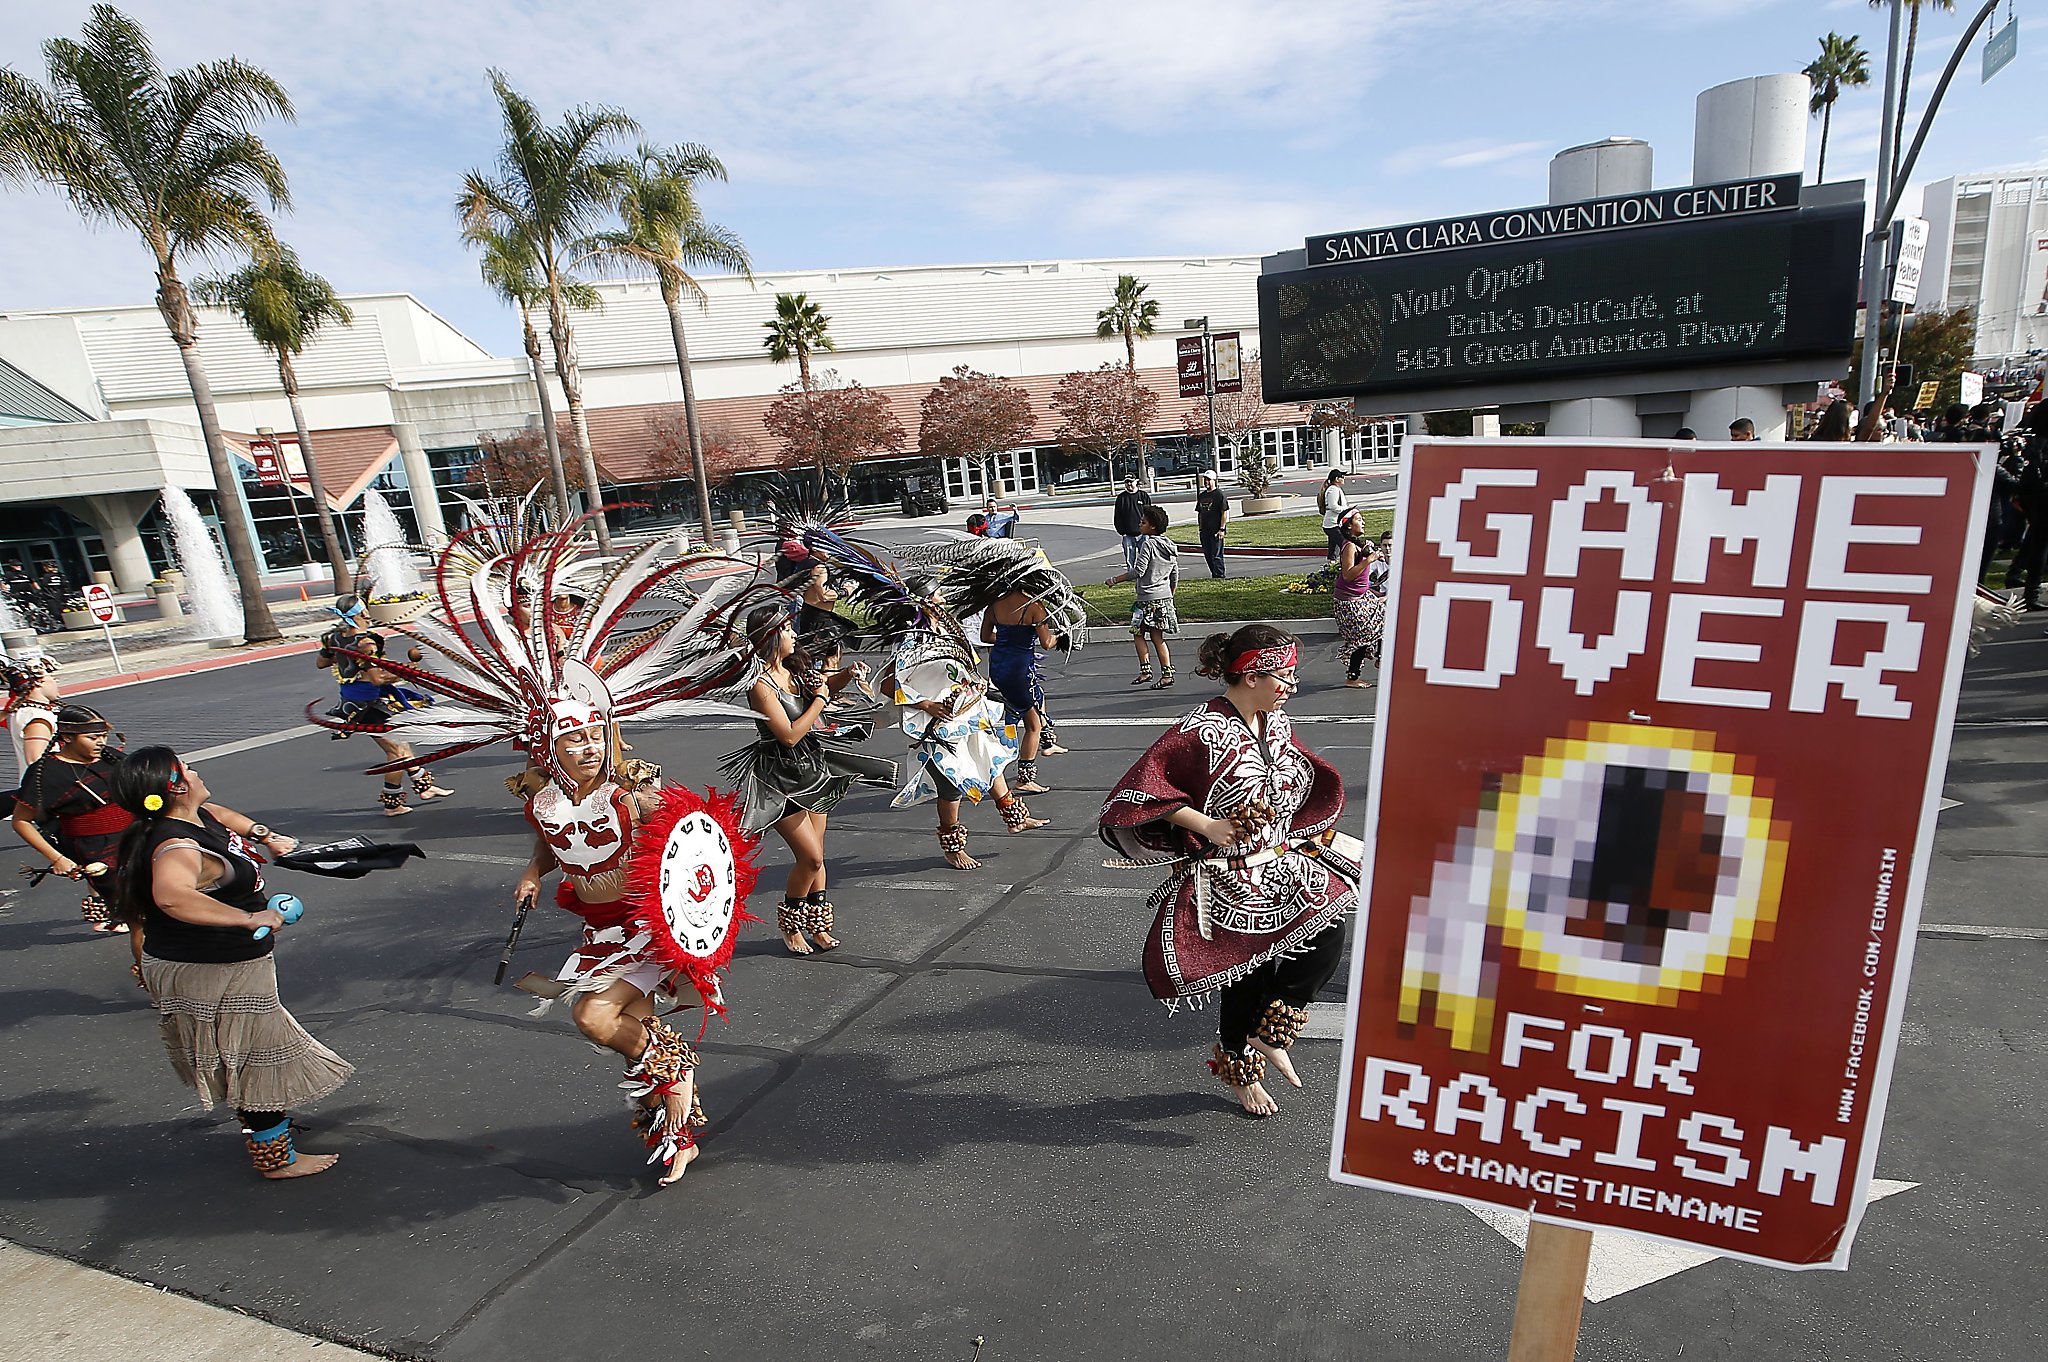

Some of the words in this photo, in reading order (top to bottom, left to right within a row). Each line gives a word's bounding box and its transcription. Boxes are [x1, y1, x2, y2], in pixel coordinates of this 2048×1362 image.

[1324, 231, 1400, 262] SANTA
[1405, 220, 1484, 251] CLARA
[1489, 195, 1664, 241] CONVENTION
[1673, 181, 1778, 218] CENTER
[1389, 283, 1456, 325] Now
[1466, 257, 1546, 303] Open
[1447, 307, 1525, 337] Erik's
[1674, 291, 1704, 316] at
[1181, 382, 1203, 390] HYATT
[1395, 345, 1454, 372] 5451
[1463, 339, 1540, 367] Great
[1545, 327, 1668, 359] America
[1677, 321, 1765, 349] Pkwy
[1426, 468, 1948, 594] GAME
[1413, 581, 1926, 720] OVER
[1501, 1011, 1701, 1095] FOR
[1360, 1056, 1847, 1206] RACISM
[1412, 1148, 1764, 1234] #CHANGETHENAME
